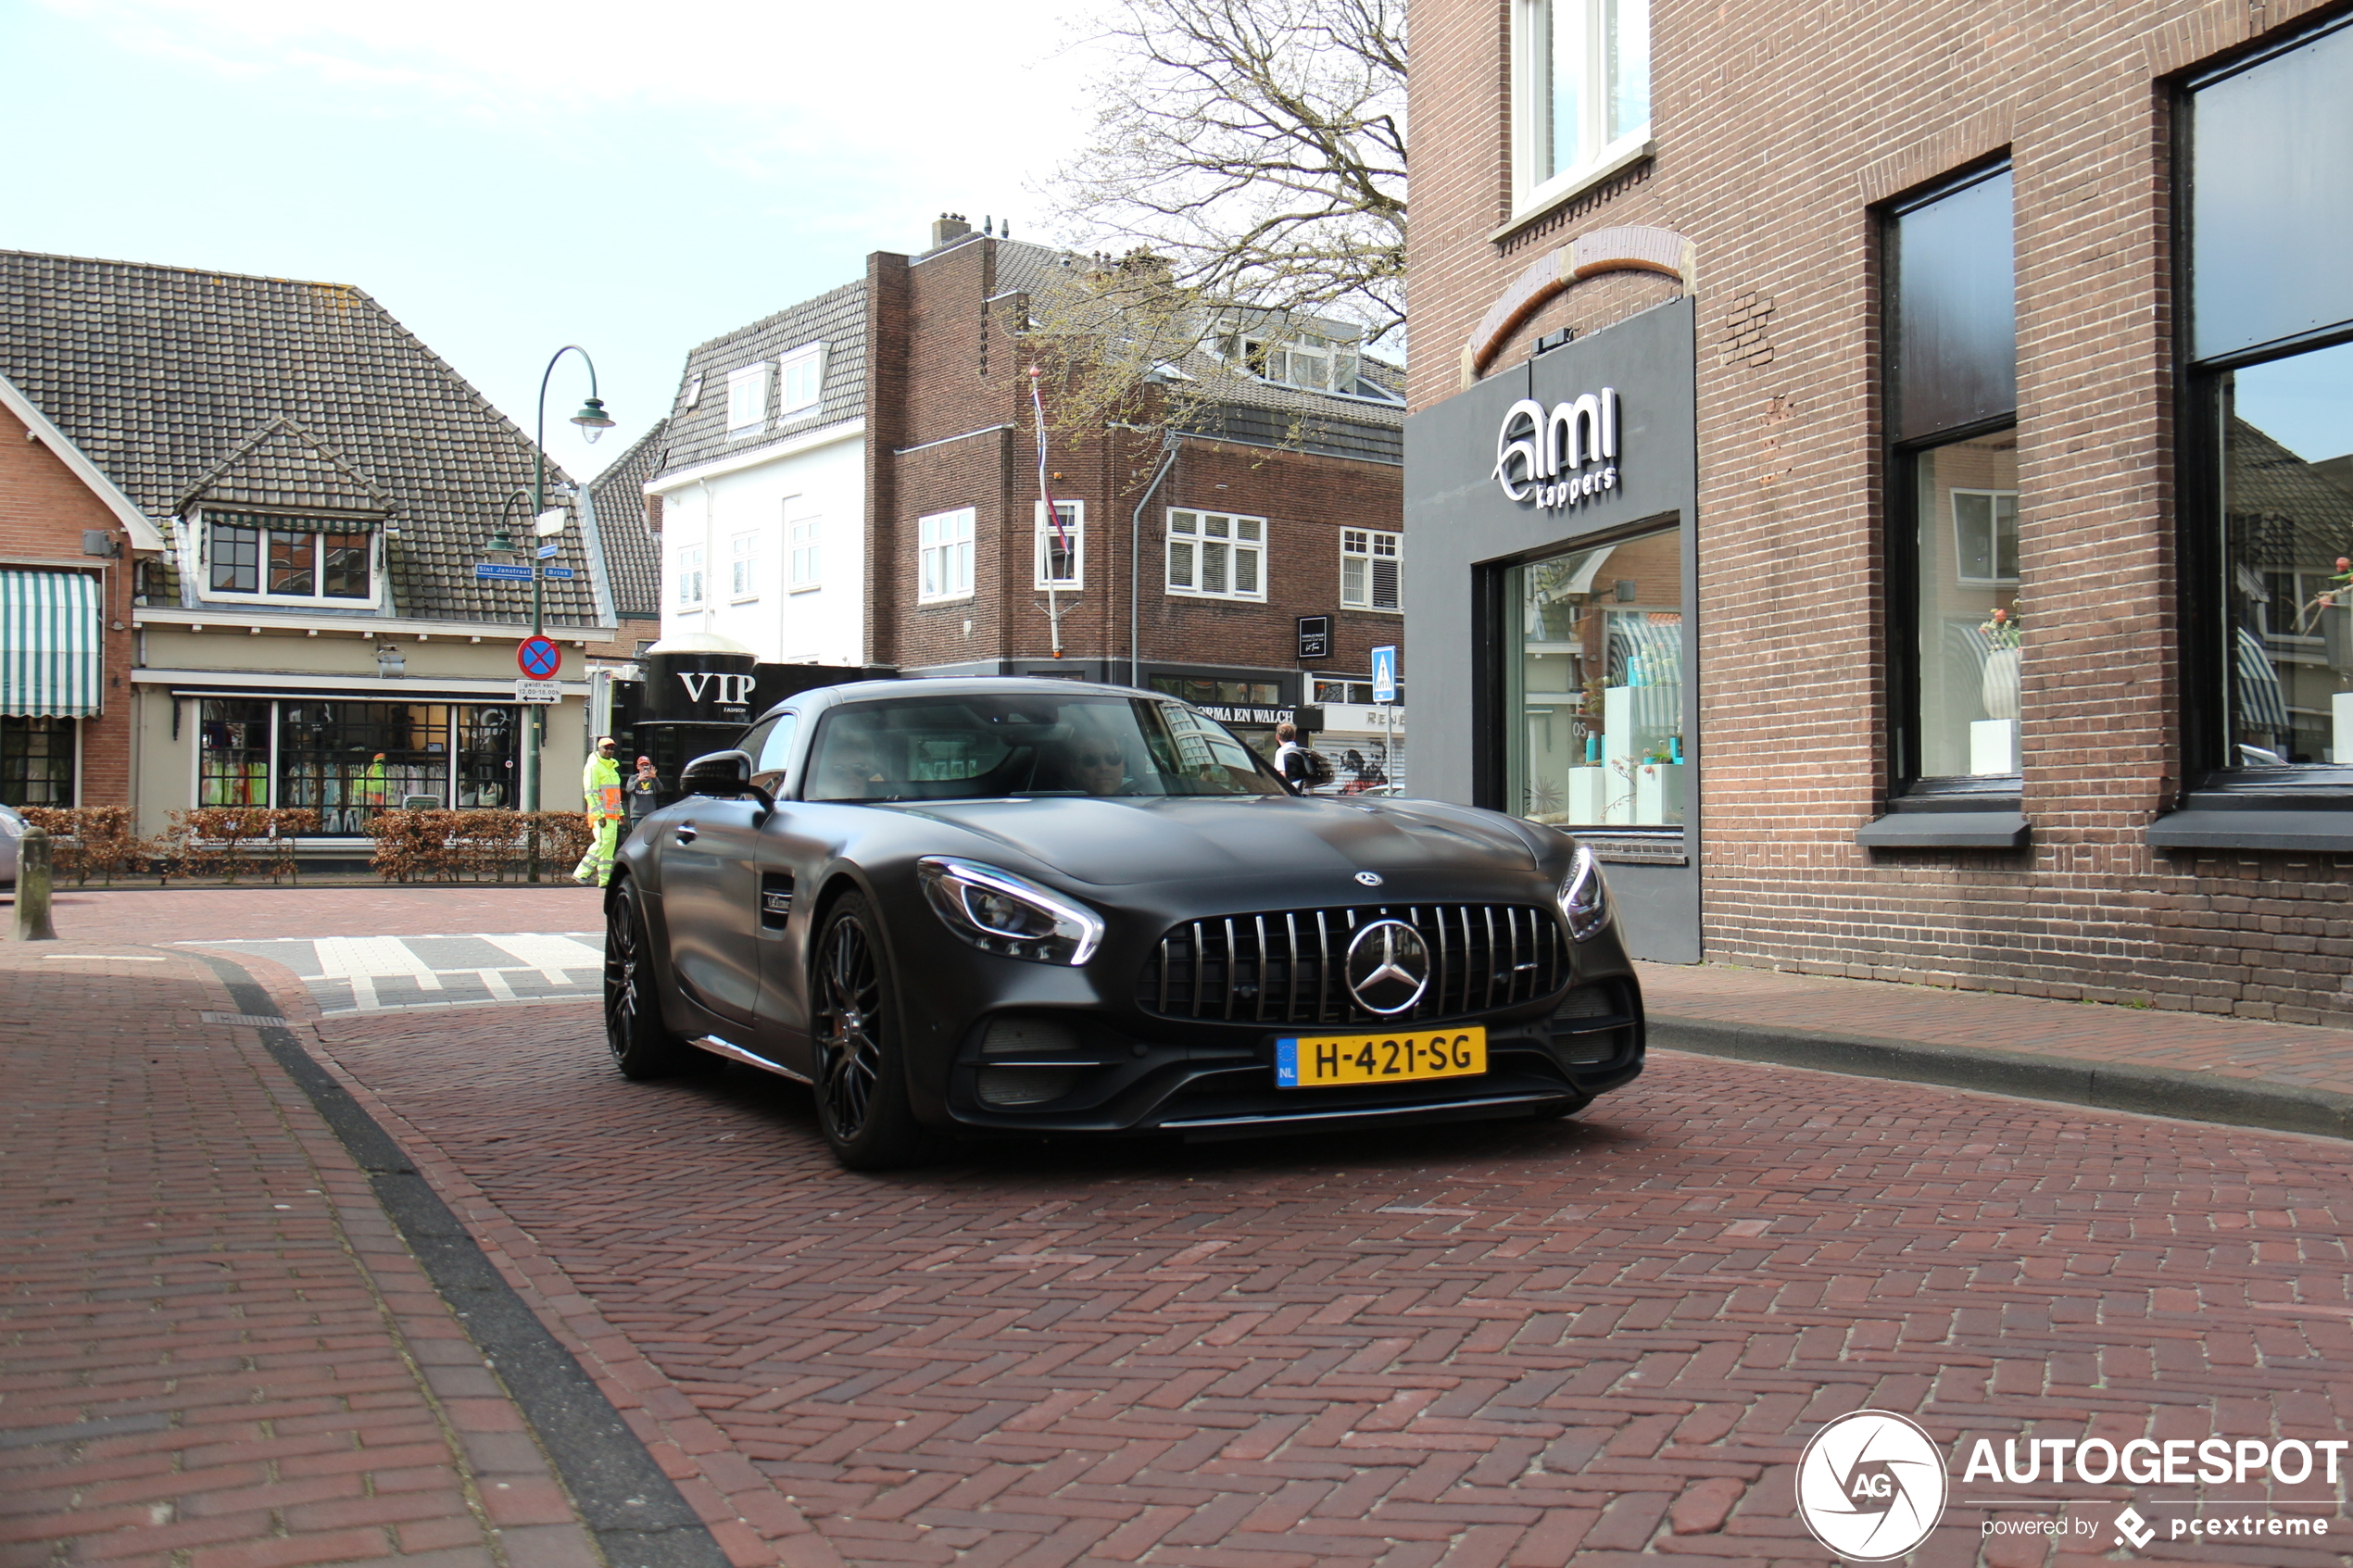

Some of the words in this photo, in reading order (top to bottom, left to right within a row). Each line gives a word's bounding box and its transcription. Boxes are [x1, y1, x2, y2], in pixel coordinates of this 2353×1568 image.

[1536, 467, 1617, 509] kappers
[496, 567, 531, 575] Janstraat
[677, 672, 756, 704] VIP
[1233, 708, 1251, 722] EN
[1252, 709, 1294, 724] WALCH
[1279, 1068, 1294, 1078] NL
[1316, 1035, 1471, 1078] H-421-SG
